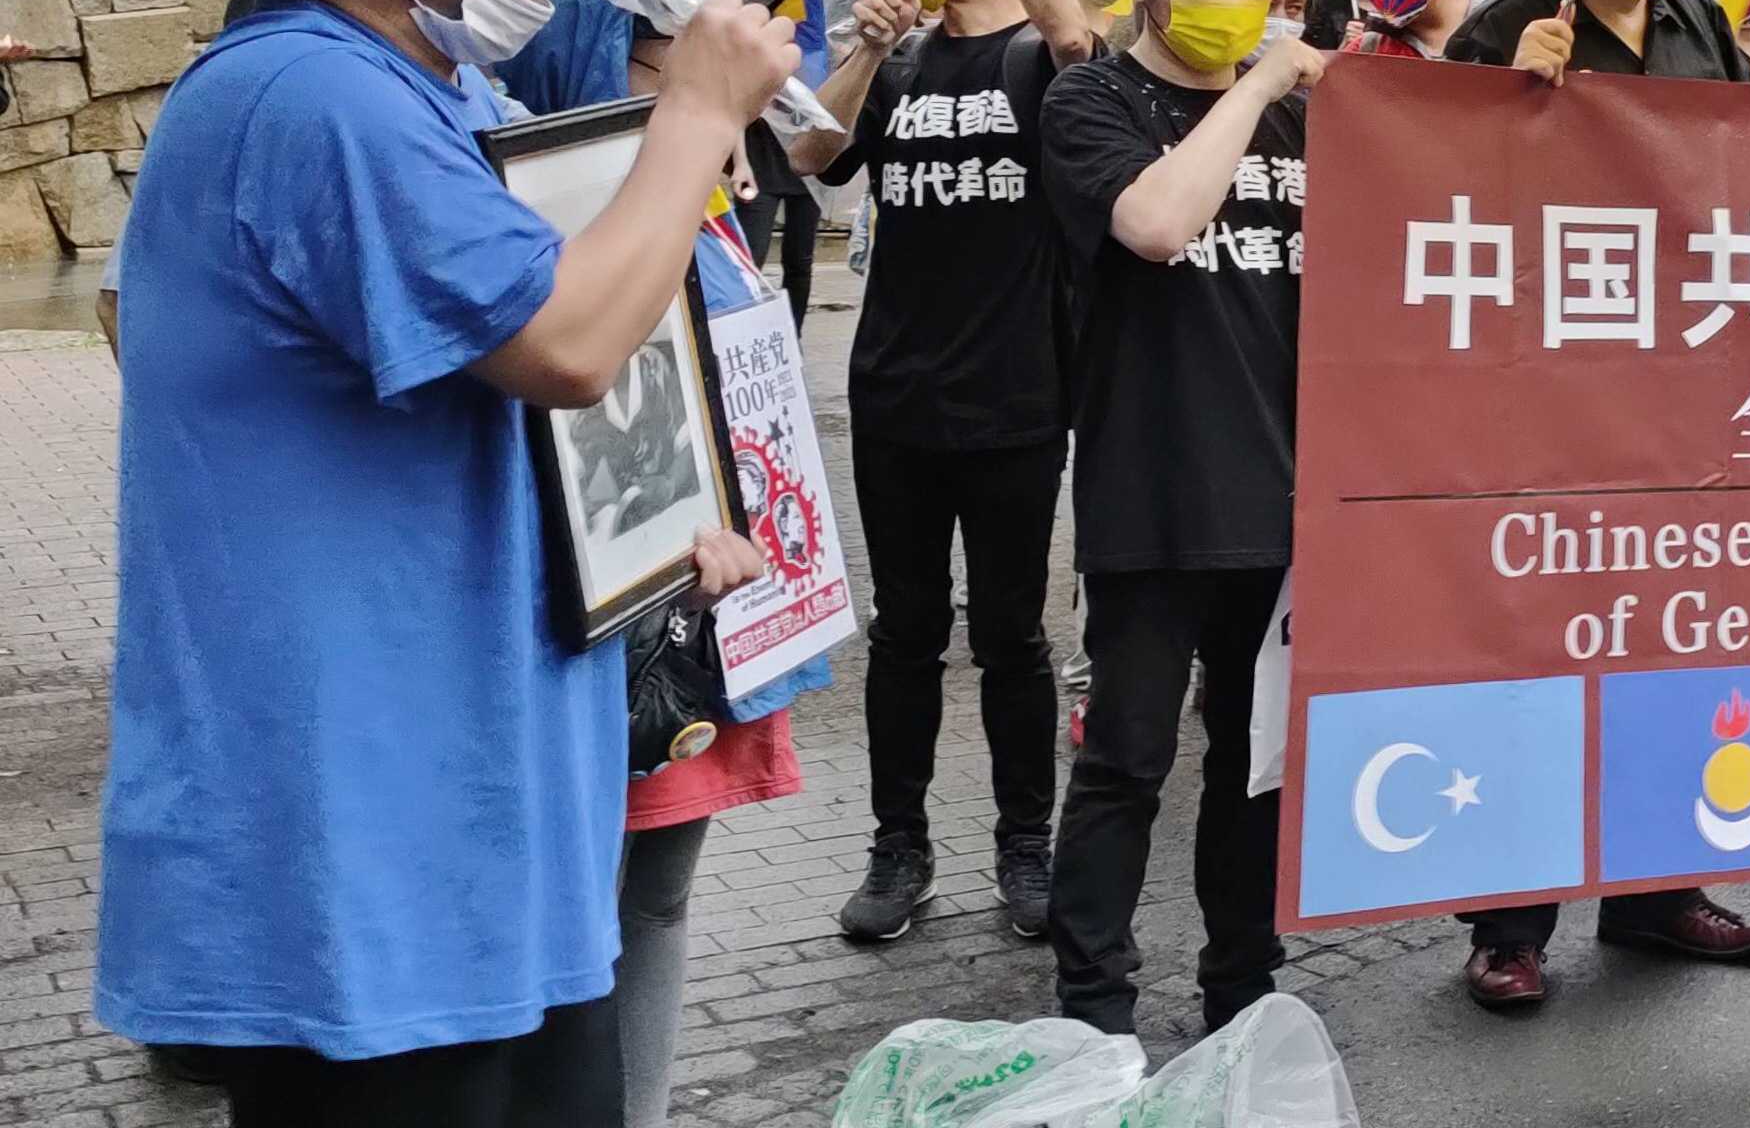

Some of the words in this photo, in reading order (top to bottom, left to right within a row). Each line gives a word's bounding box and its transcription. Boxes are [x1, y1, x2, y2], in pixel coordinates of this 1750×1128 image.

[881, 156, 1029, 208] 時代革命
[1563, 593, 1639, 660] of
